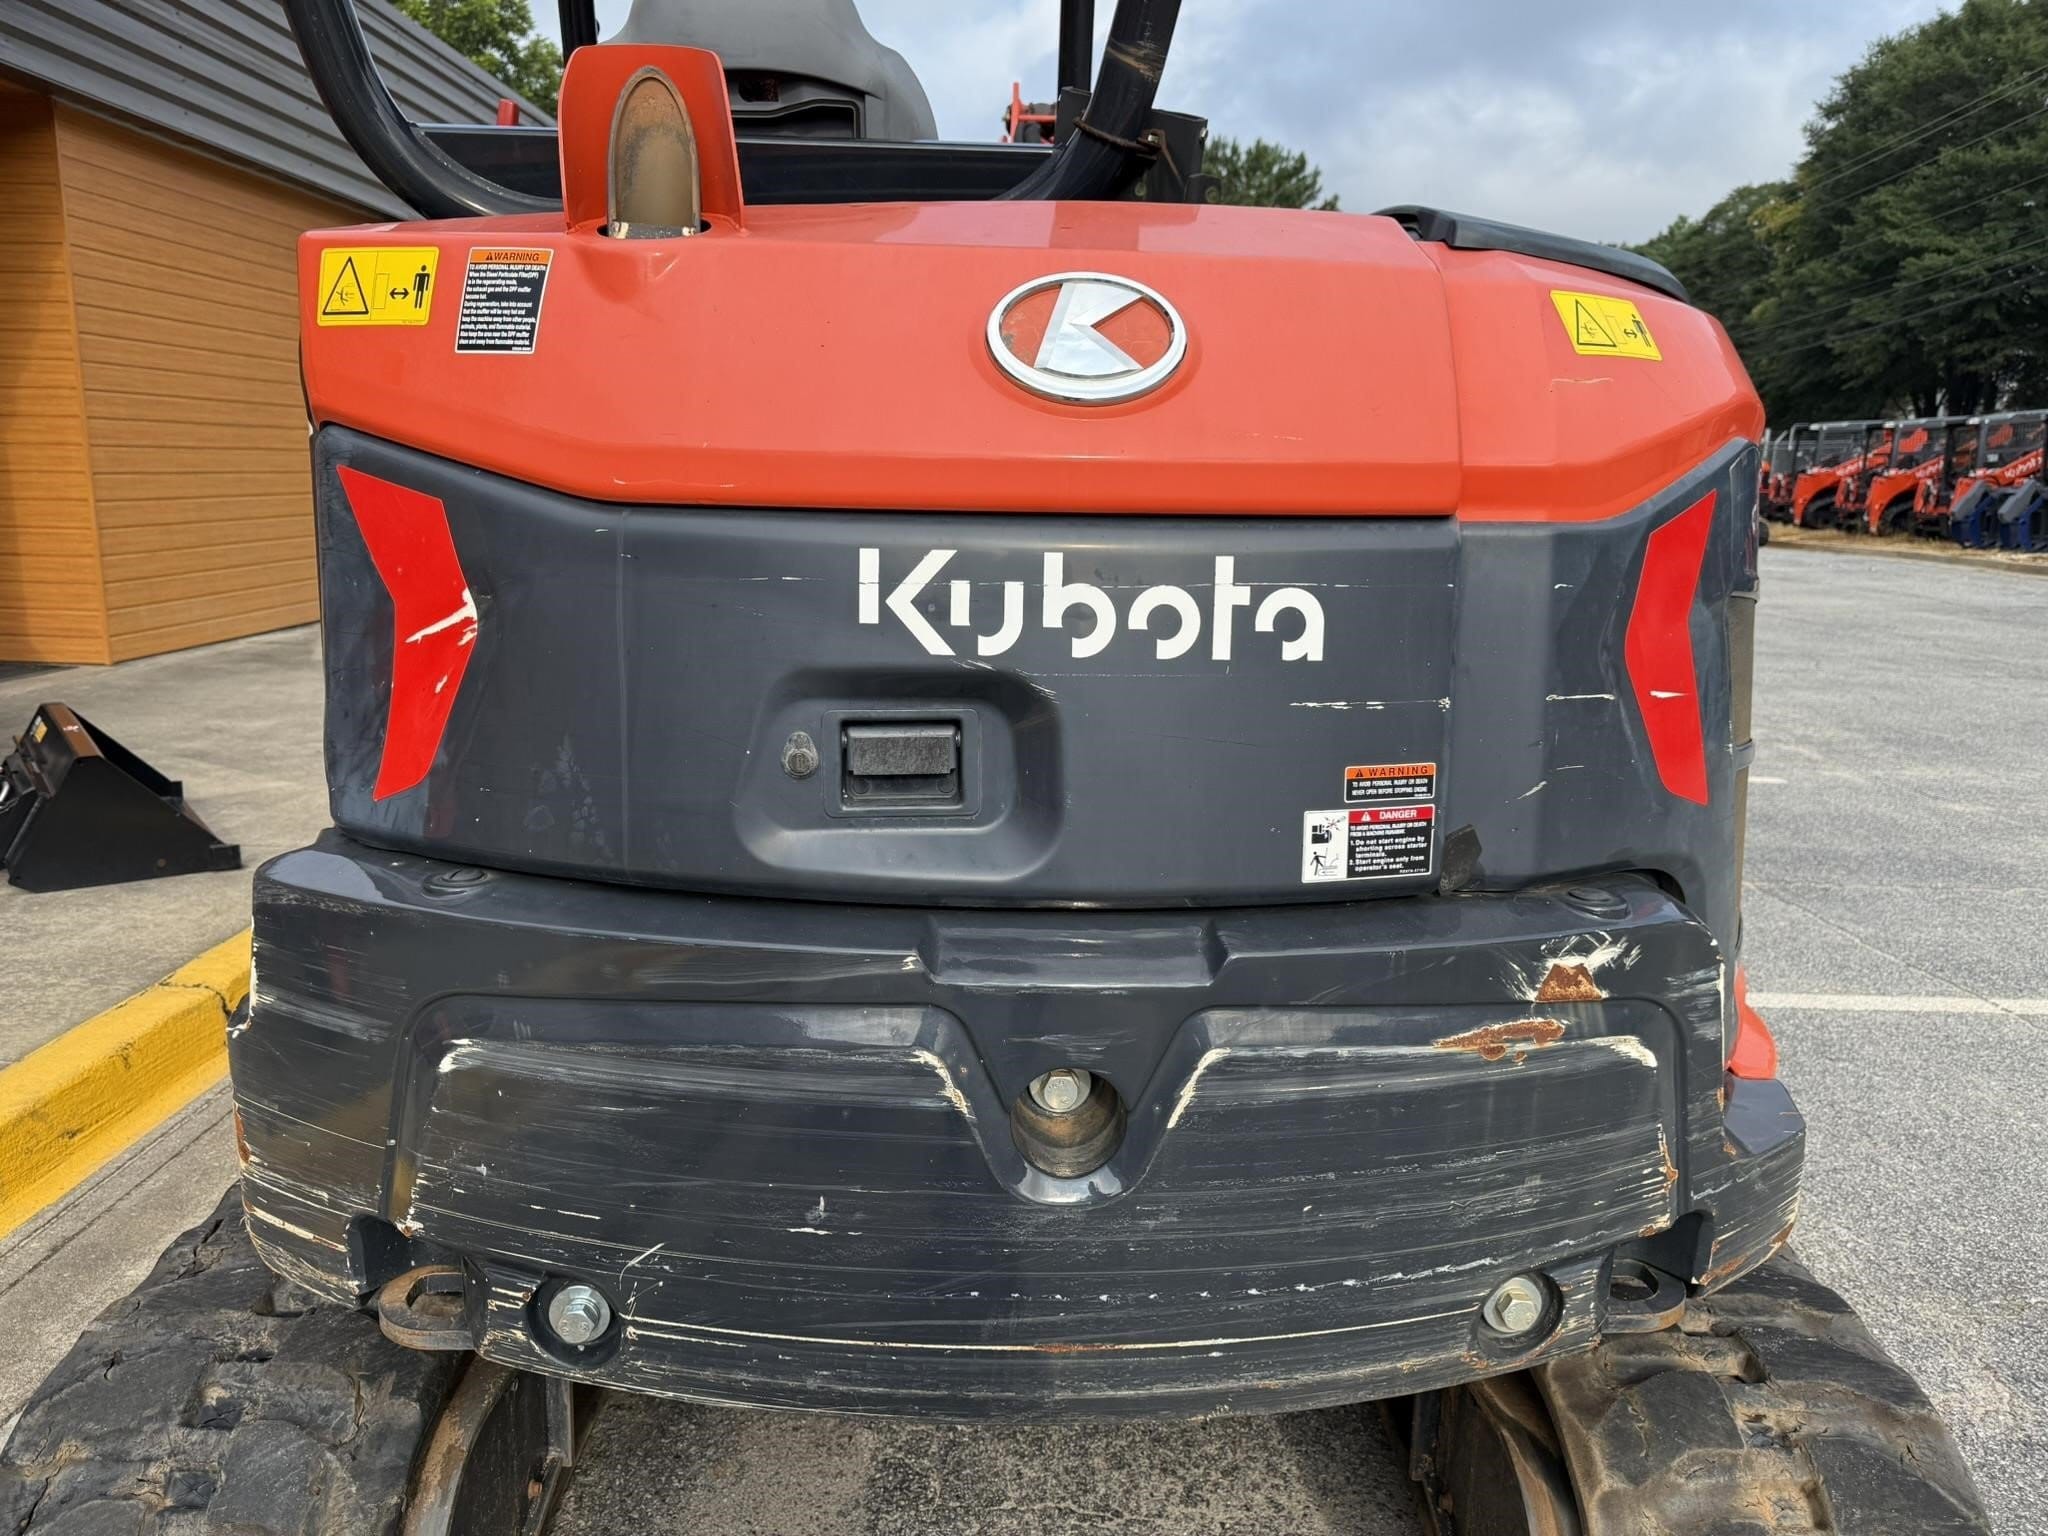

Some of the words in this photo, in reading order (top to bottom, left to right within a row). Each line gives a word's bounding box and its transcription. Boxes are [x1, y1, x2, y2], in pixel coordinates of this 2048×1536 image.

[494, 252, 539, 261] WARNING
[859, 548, 1325, 661] Kubota
[1369, 766, 1428, 776] WARNING
[1380, 810, 1417, 819] DANGER
